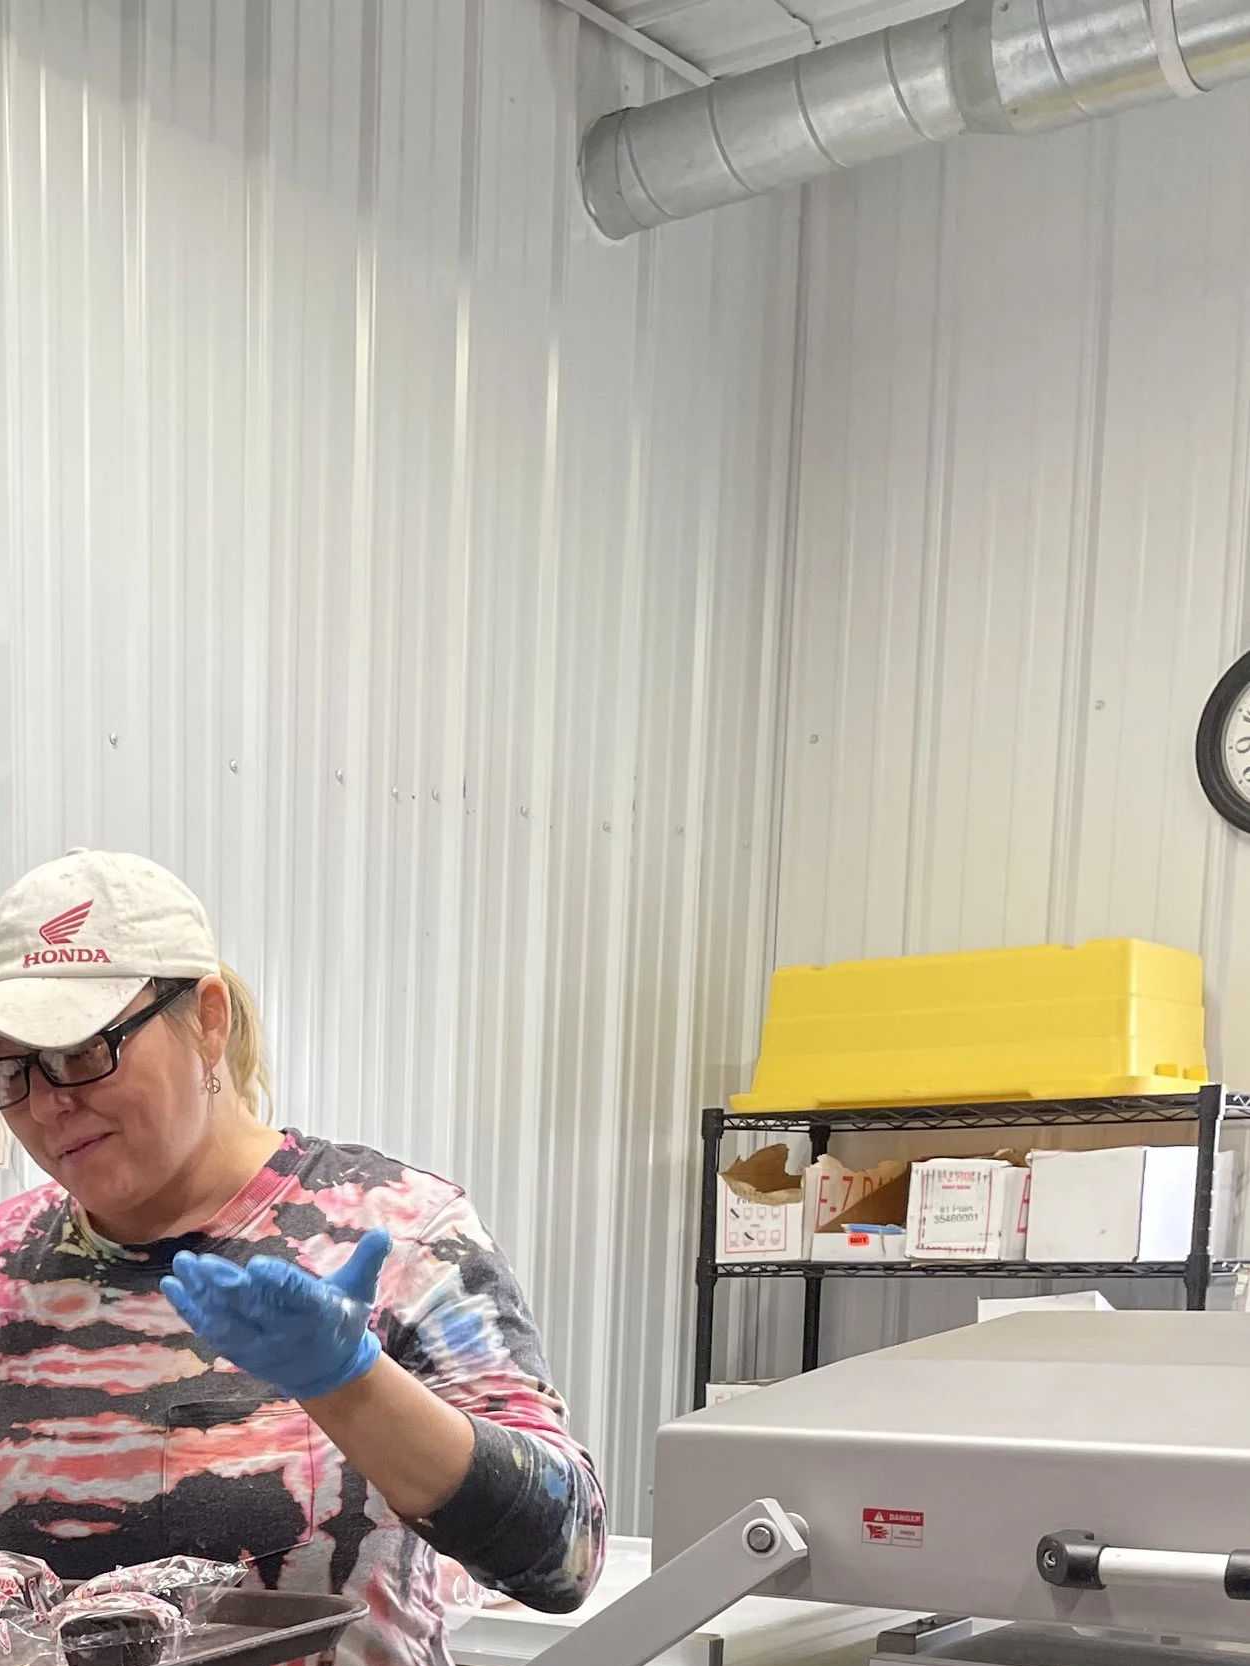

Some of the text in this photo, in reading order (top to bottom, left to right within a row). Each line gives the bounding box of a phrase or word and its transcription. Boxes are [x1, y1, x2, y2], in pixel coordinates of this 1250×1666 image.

[22, 948, 112, 969] HONDA
[933, 1213, 979, 1225] 35460001
[889, 1514, 921, 1522] DANGER
